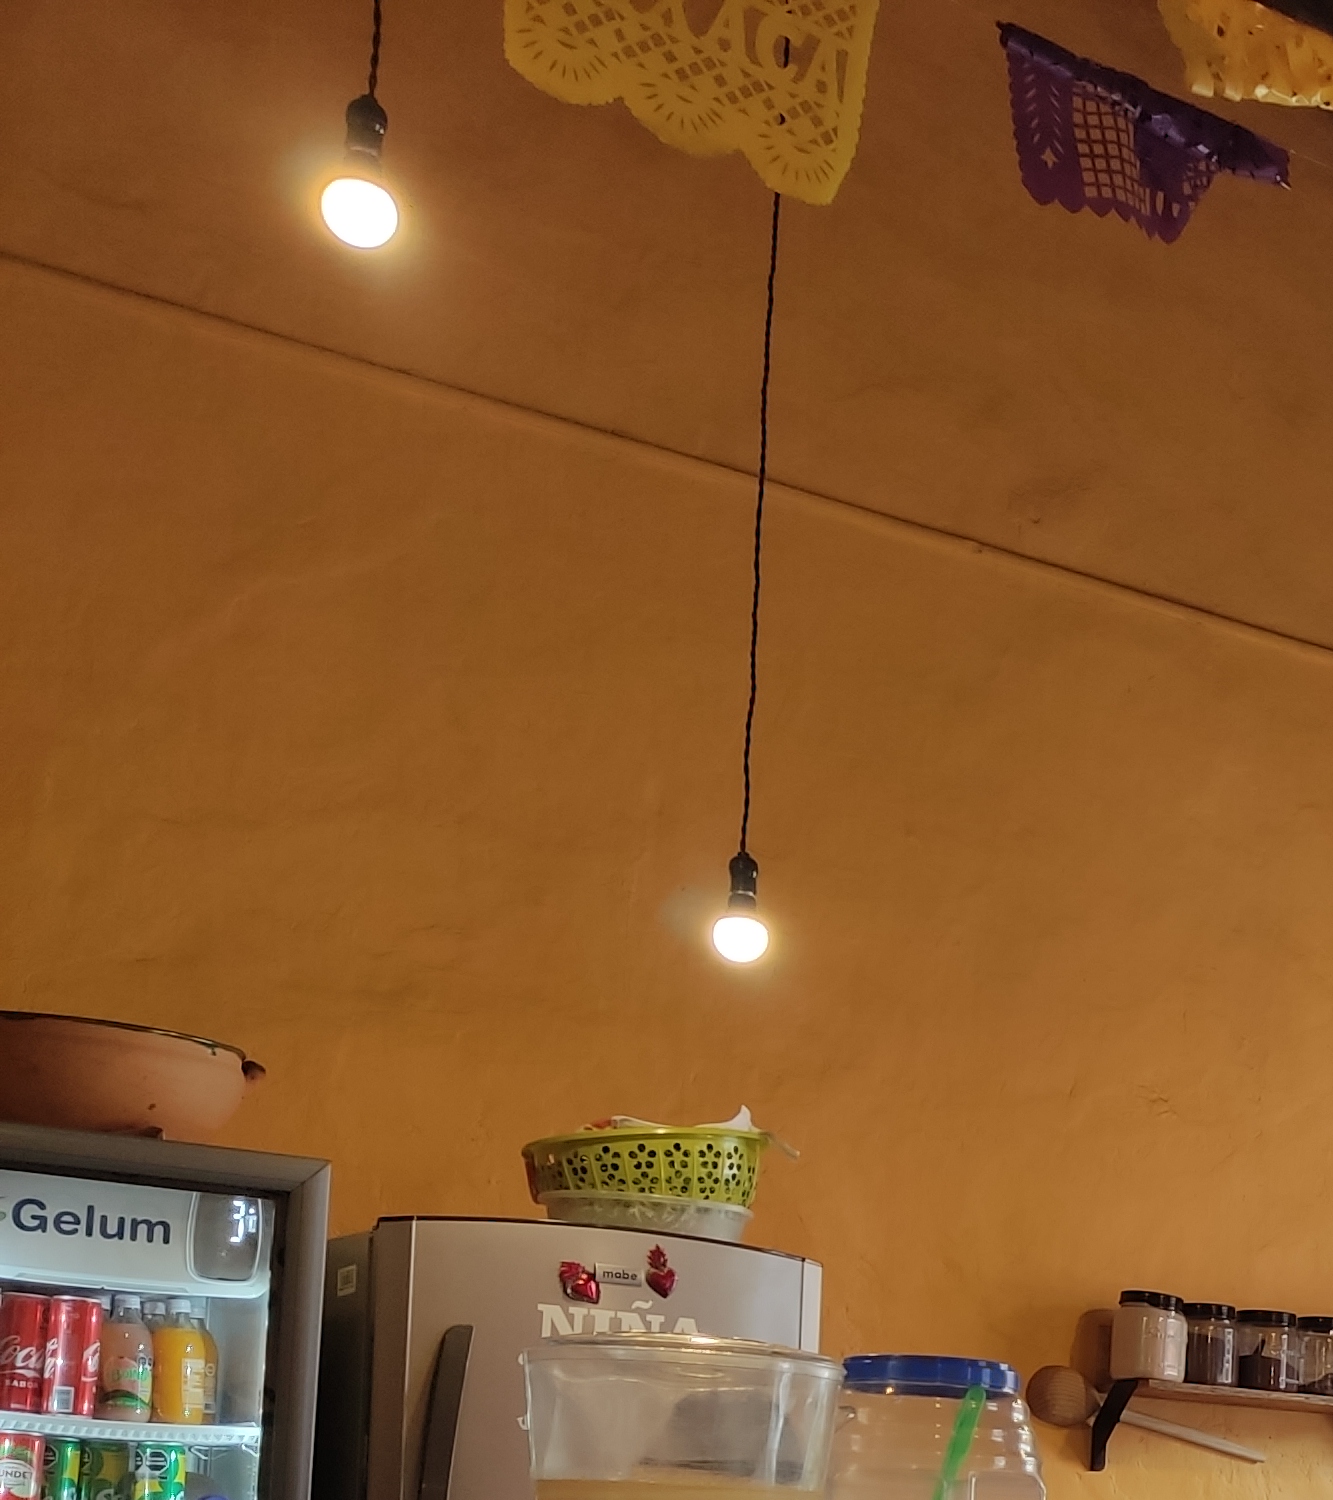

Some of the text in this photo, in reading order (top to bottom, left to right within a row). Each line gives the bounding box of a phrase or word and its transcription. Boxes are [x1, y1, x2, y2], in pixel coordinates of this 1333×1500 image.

[12, 1198, 171, 1245] Gelum
[602, 1268, 638, 1282] mabe
[537, 1300, 701, 1338] NIÑA
